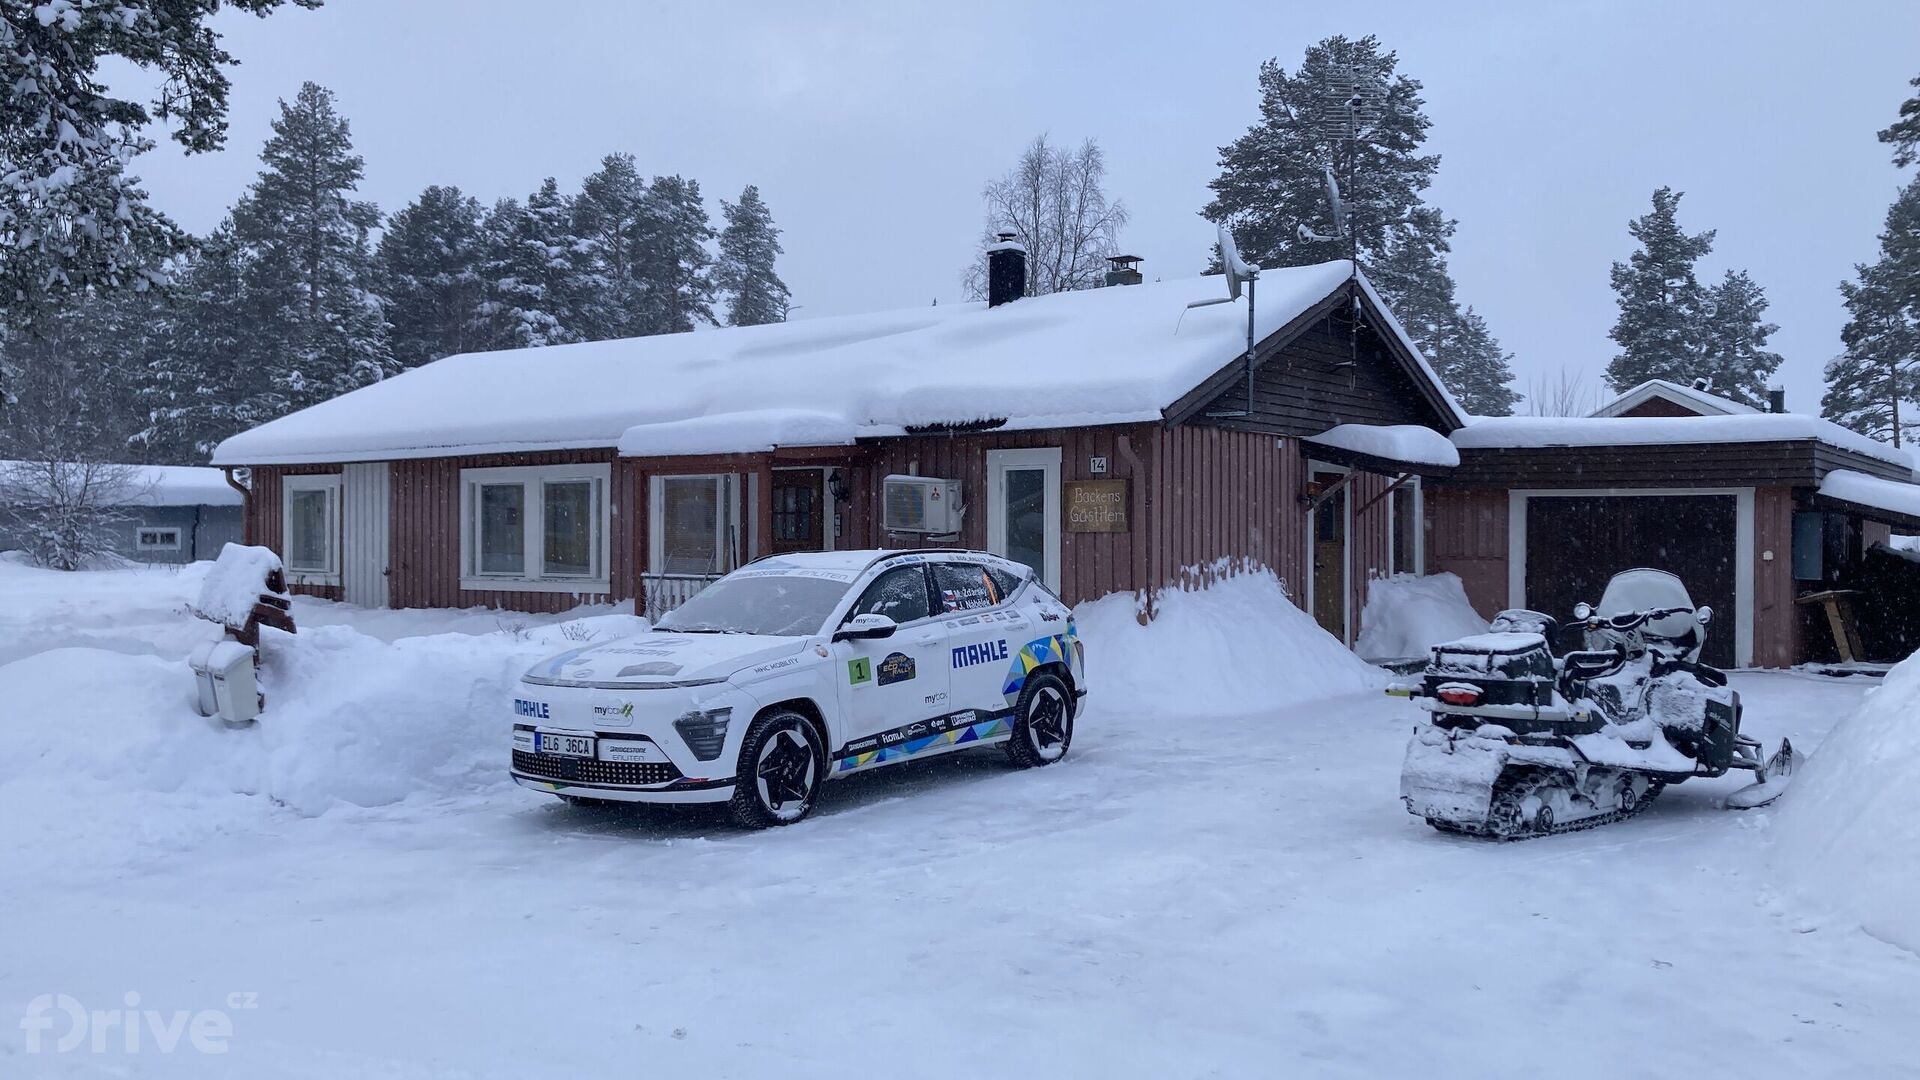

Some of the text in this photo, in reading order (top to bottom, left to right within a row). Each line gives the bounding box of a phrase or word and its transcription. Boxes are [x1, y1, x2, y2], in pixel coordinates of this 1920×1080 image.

[1091, 459, 1105, 471] 14
[952, 639, 1009, 669] MAHLE
[855, 662, 865, 680] 1
[883, 663, 898, 672] ECO
[893, 664, 912, 677] RALLY
[514, 698, 550, 719] MAHLE
[542, 735, 559, 751] EL6
[565, 738, 590, 755] 36CA
